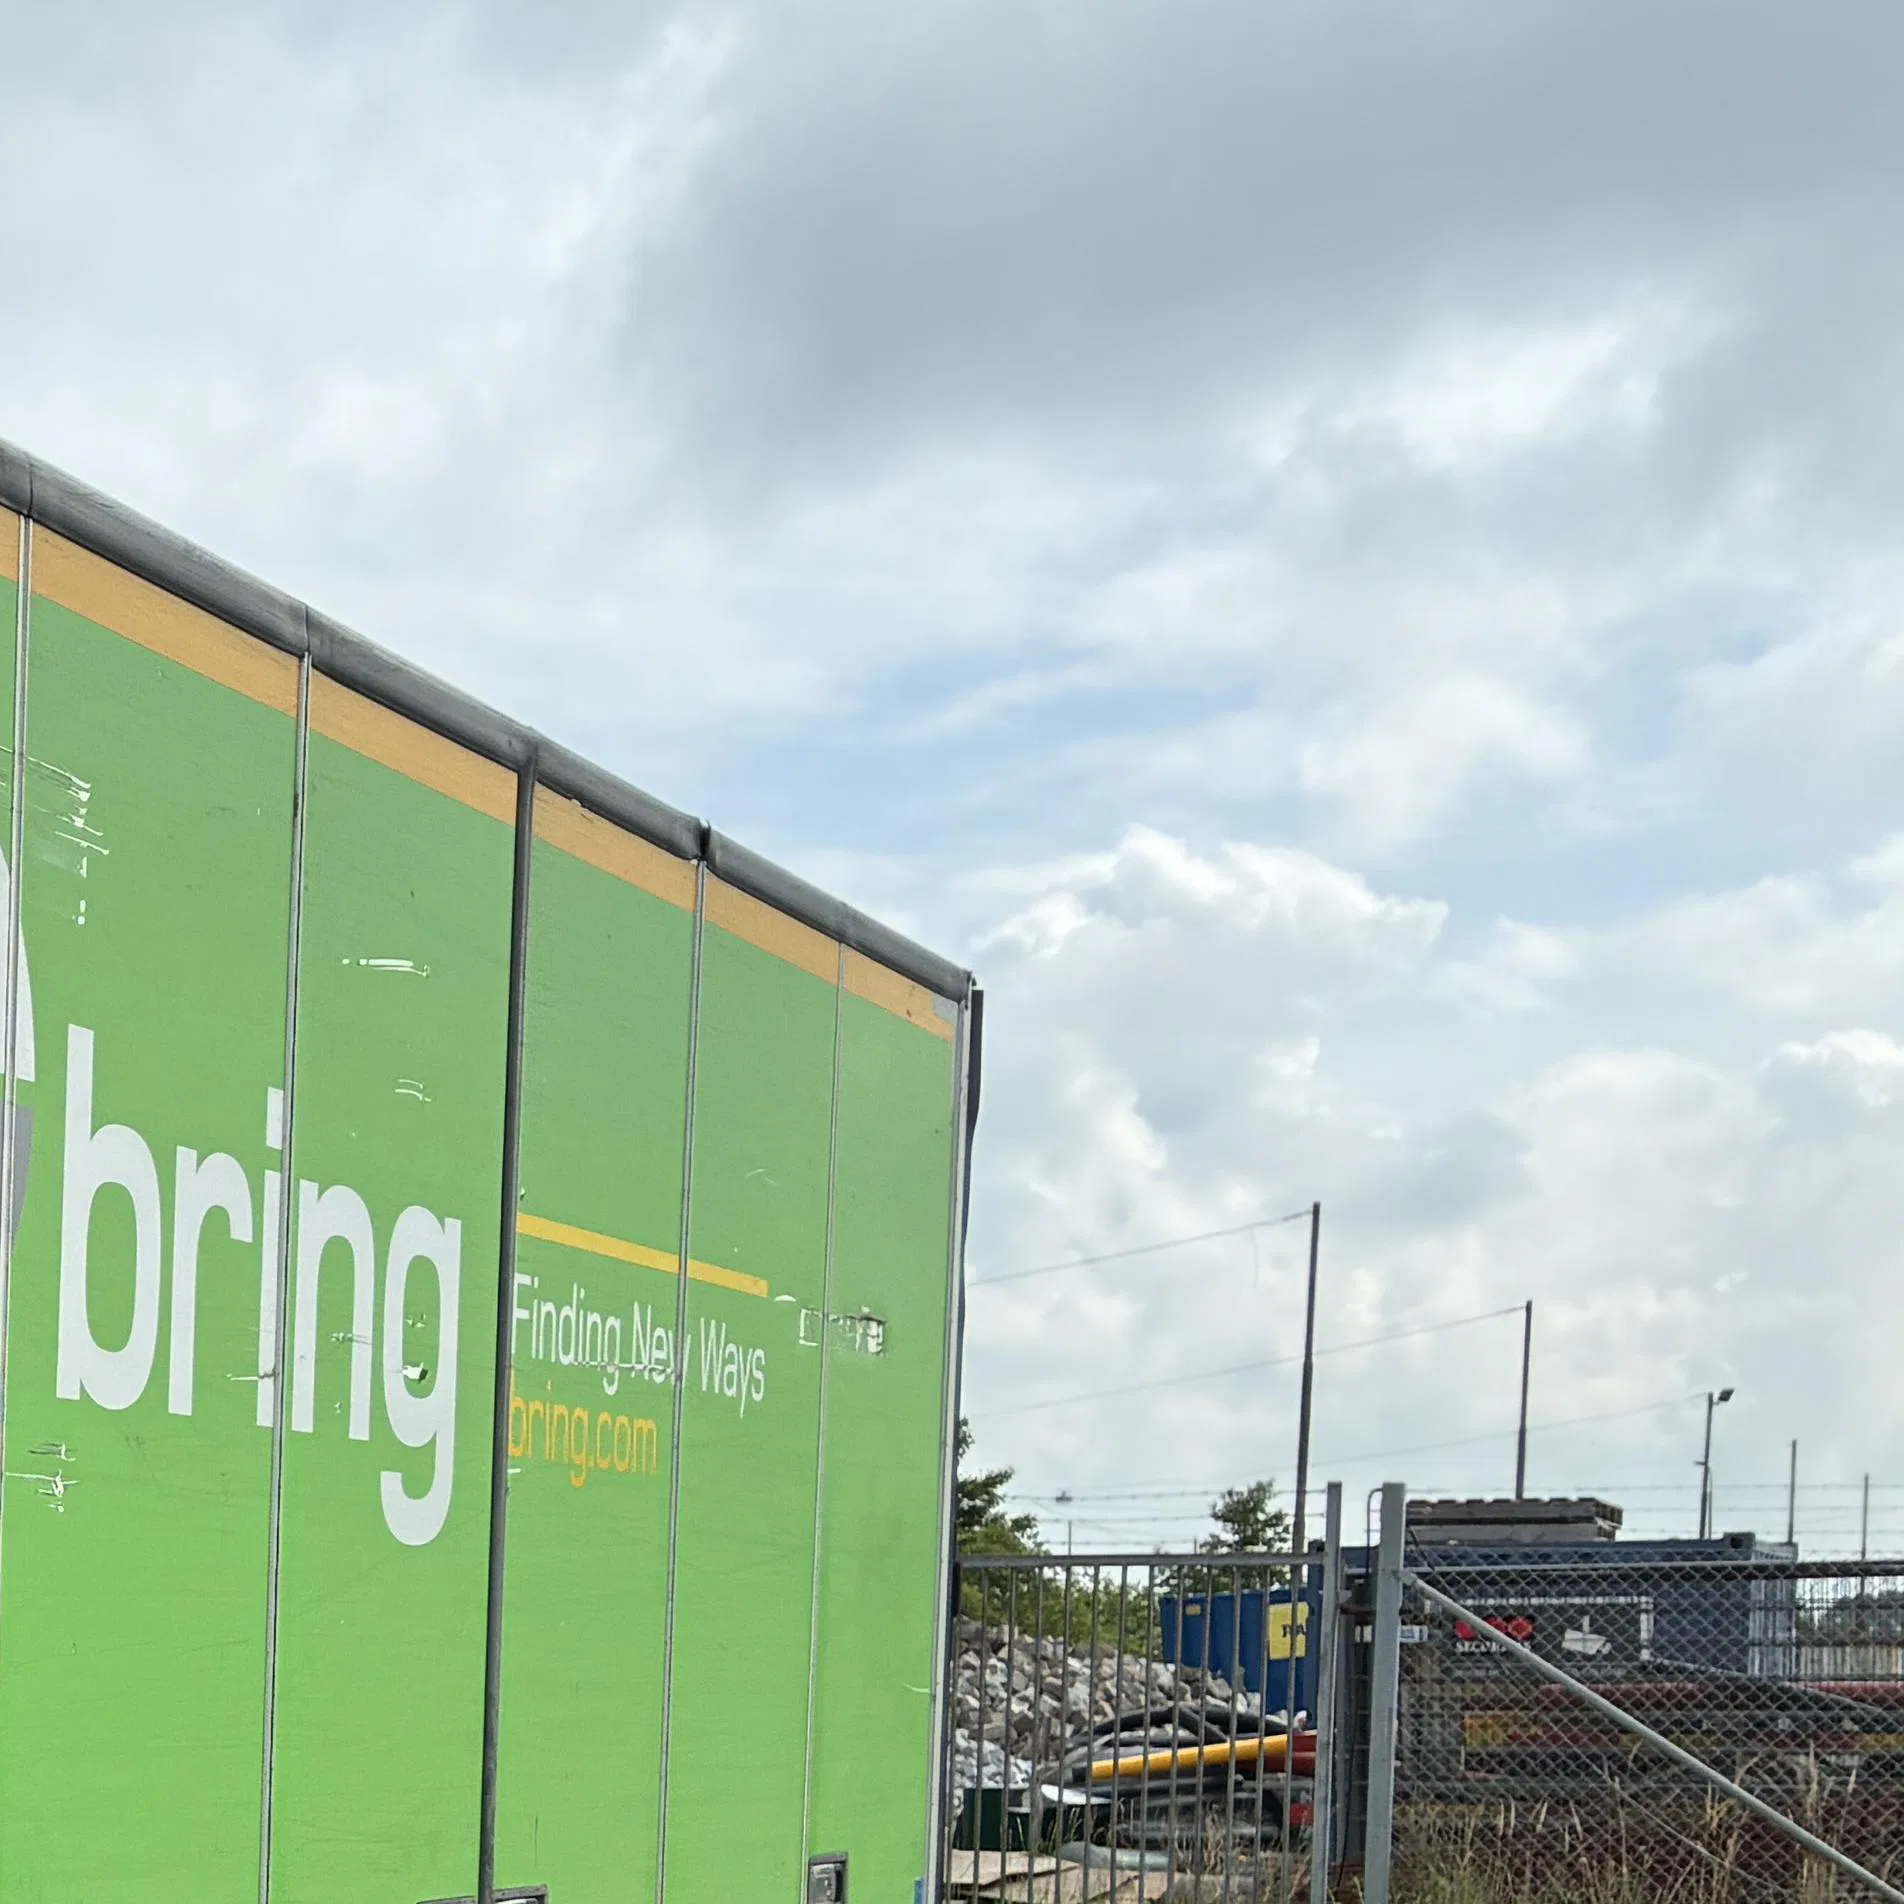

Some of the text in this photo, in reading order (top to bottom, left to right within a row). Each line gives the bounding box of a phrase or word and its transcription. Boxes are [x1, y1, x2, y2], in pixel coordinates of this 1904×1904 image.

[56, 1023, 462, 1546] bring
[512, 1273, 621, 1396] Finding
[700, 1317, 767, 1419] Ways
[508, 1367, 658, 1488] bring.com
